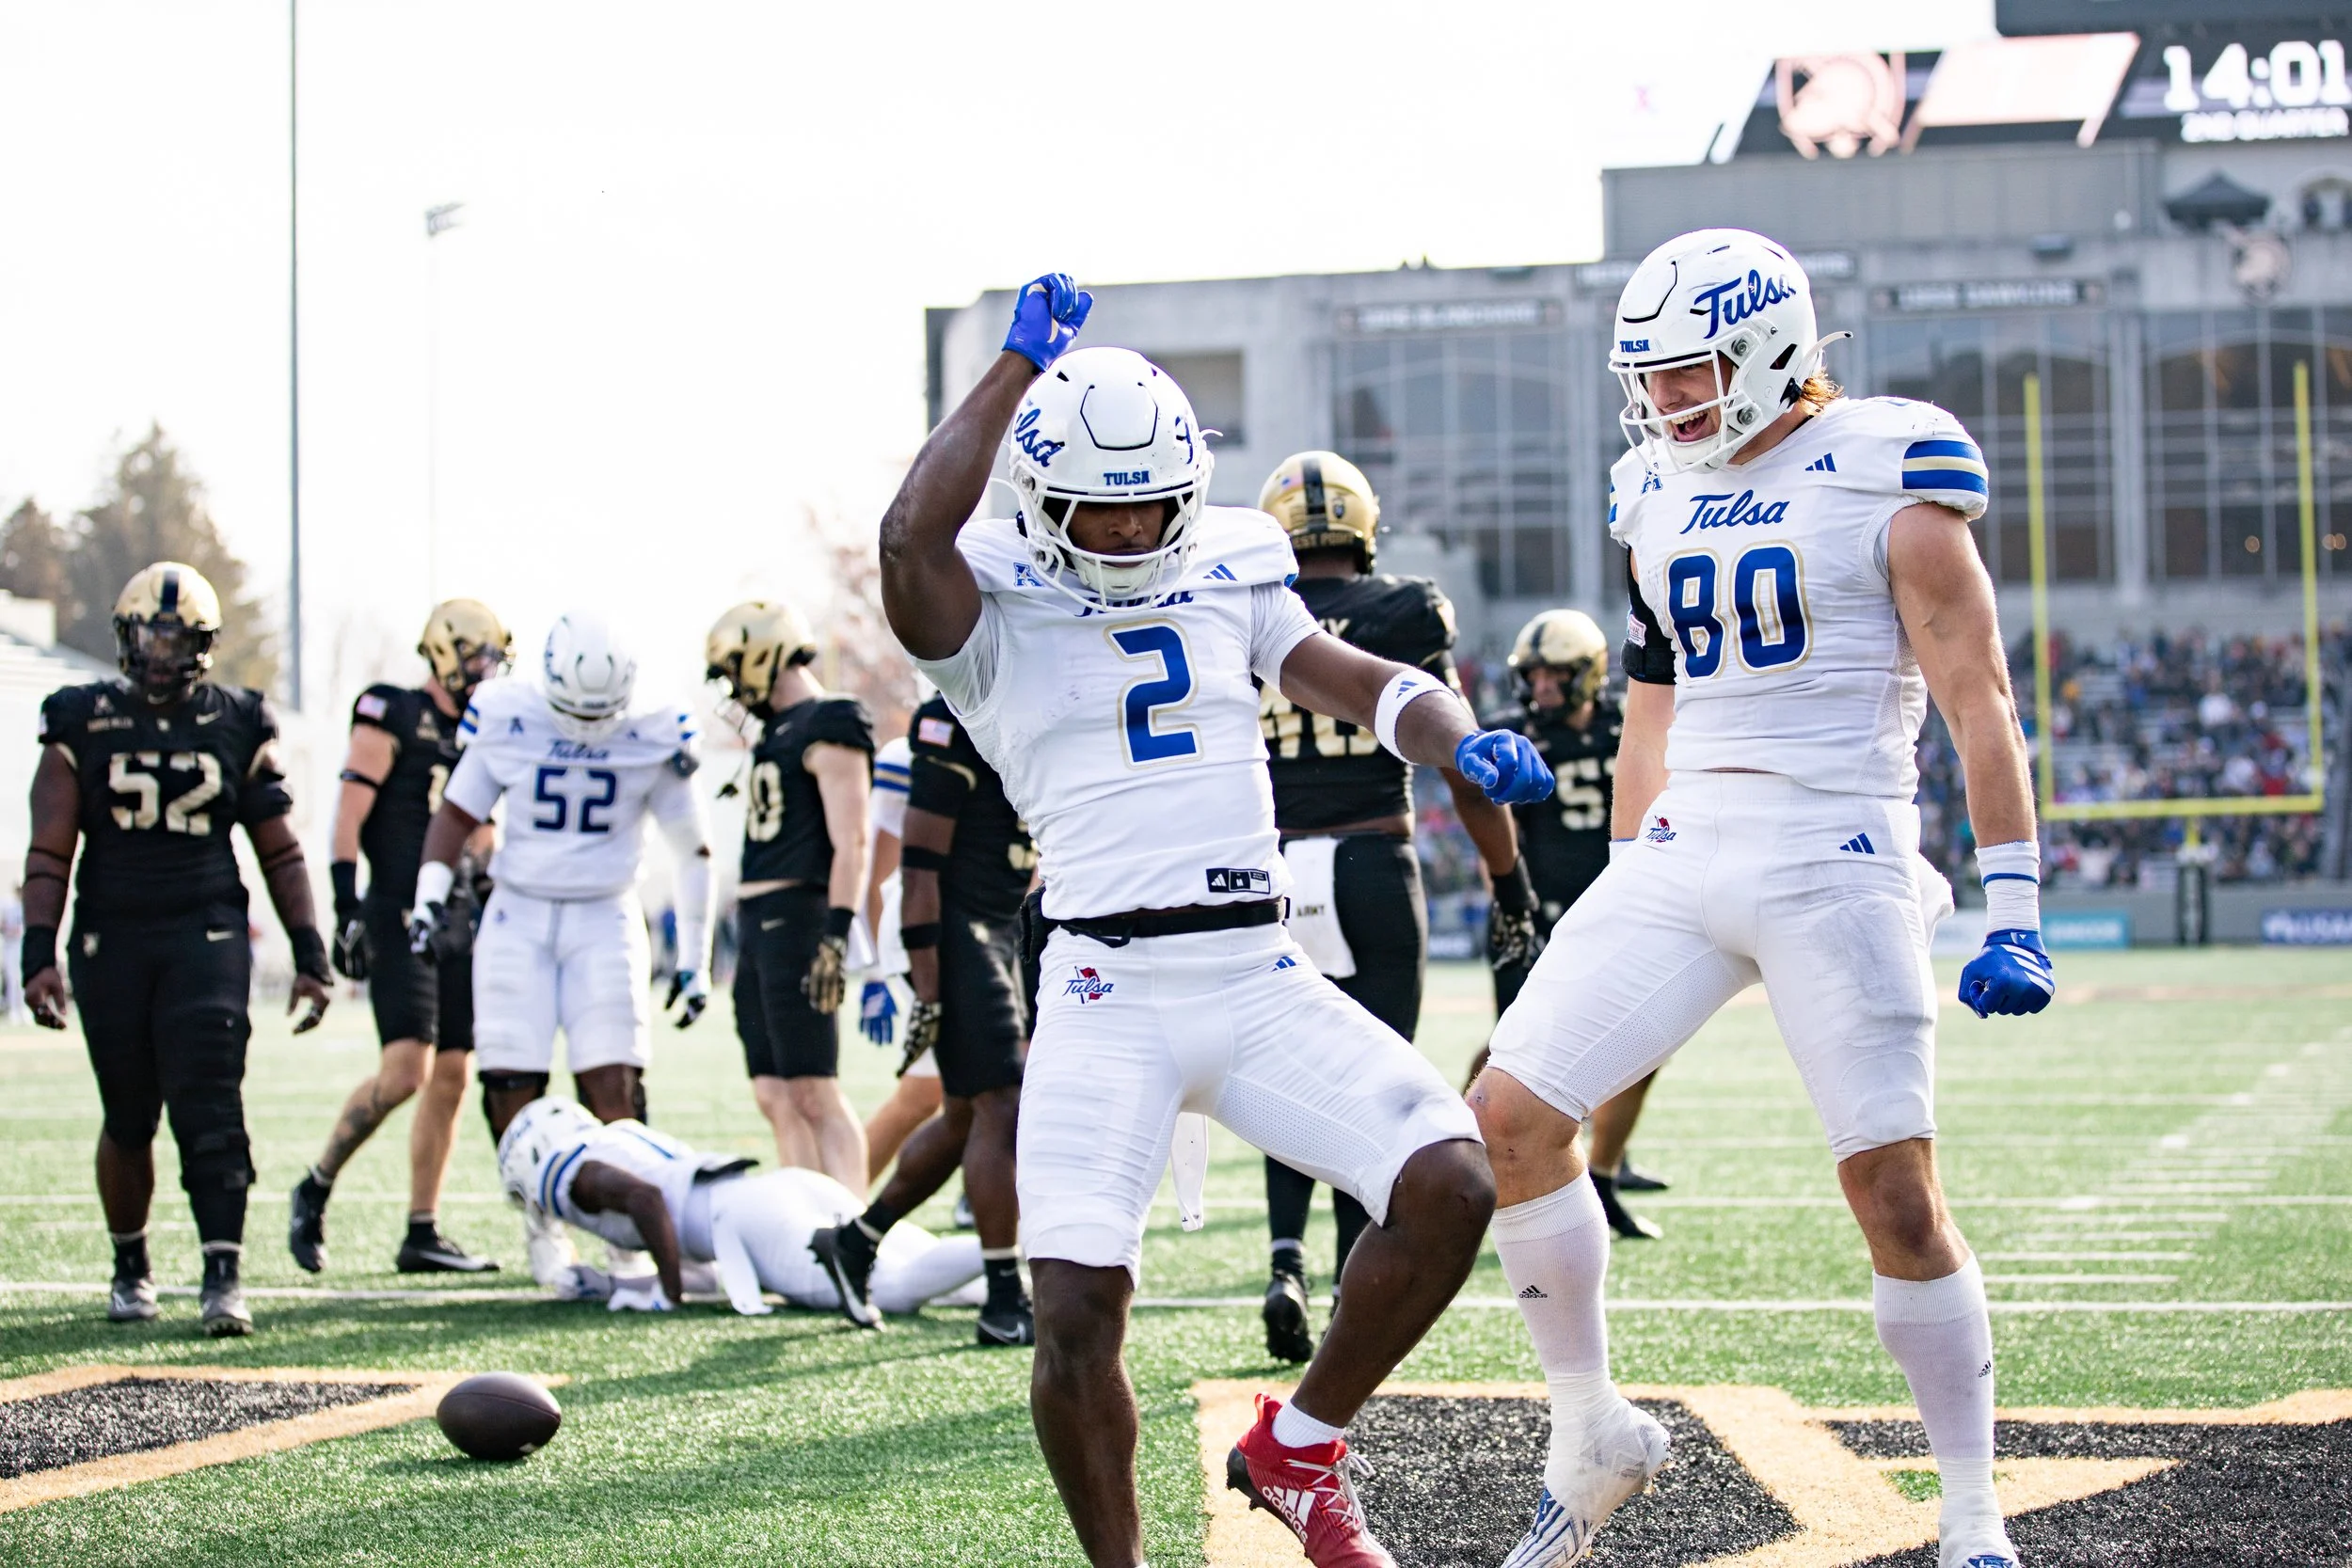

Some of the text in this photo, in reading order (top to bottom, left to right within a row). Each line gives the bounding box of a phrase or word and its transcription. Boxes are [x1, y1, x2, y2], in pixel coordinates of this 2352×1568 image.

[2163, 40, 2352, 112] 14:01
[1620, 340, 1650, 353] TULSA
[1104, 471, 1151, 486] TULSA
[1679, 489, 1790, 535] Tulsa
[1663, 539, 1814, 683] 80
[1104, 618, 1204, 769] 2
[548, 737, 612, 760] Tulsa
[109, 752, 222, 836] 52
[532, 765, 618, 833] 52
[1062, 977, 1114, 996] Tulsa
[1263, 1486, 1309, 1544] adidas
